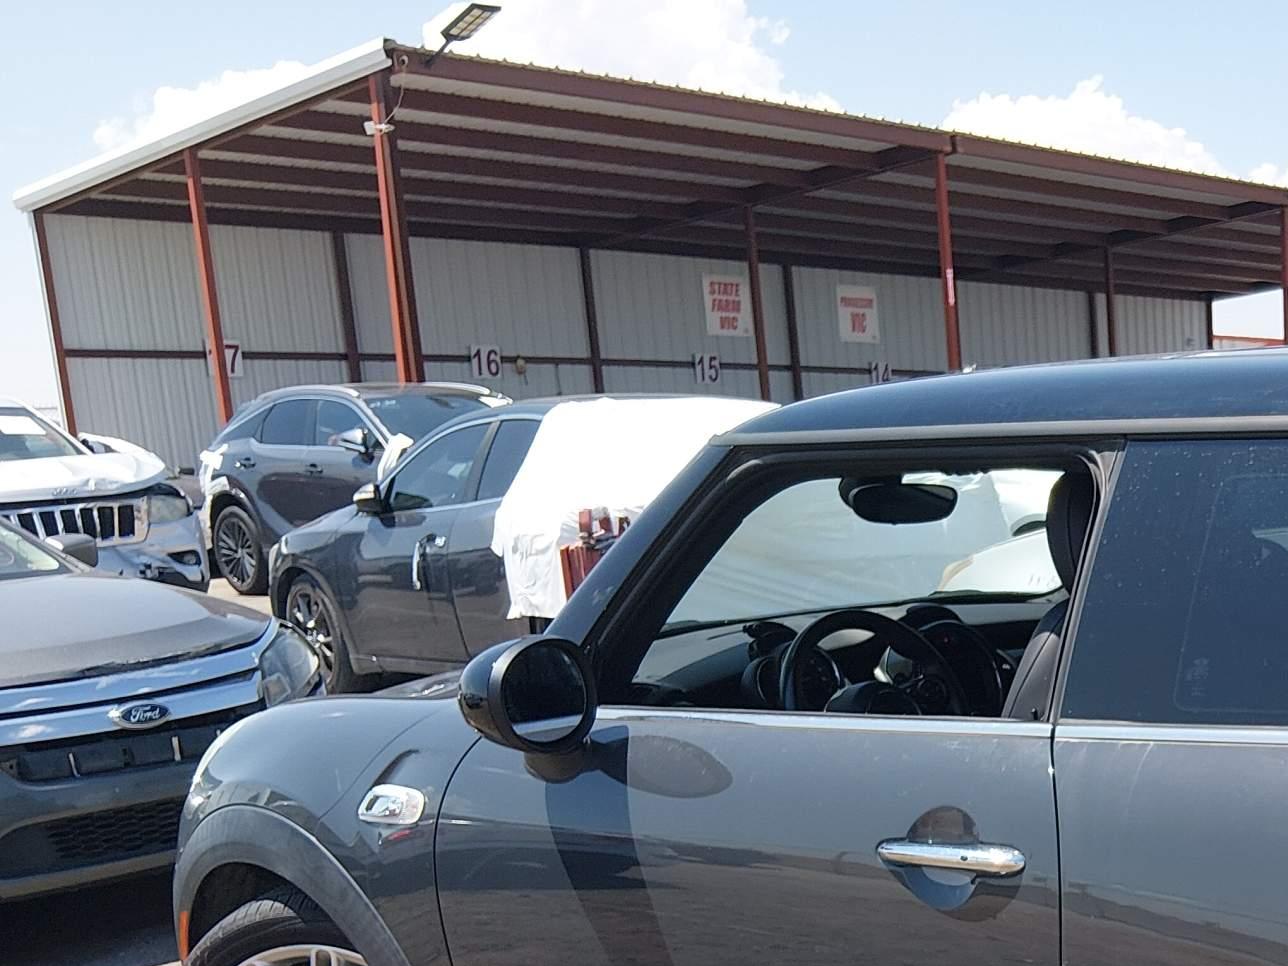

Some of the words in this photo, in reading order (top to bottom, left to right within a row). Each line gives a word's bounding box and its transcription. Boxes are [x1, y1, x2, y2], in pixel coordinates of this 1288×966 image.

[709, 281, 741, 298] STATE
[711, 298, 742, 314] FARM
[719, 316, 738, 331] VIC
[850, 311, 868, 334] VIC
[473, 348, 501, 377] 16
[697, 355, 720, 383] 15
[871, 362, 890, 384] 14
[130, 705, 161, 723] Ford
